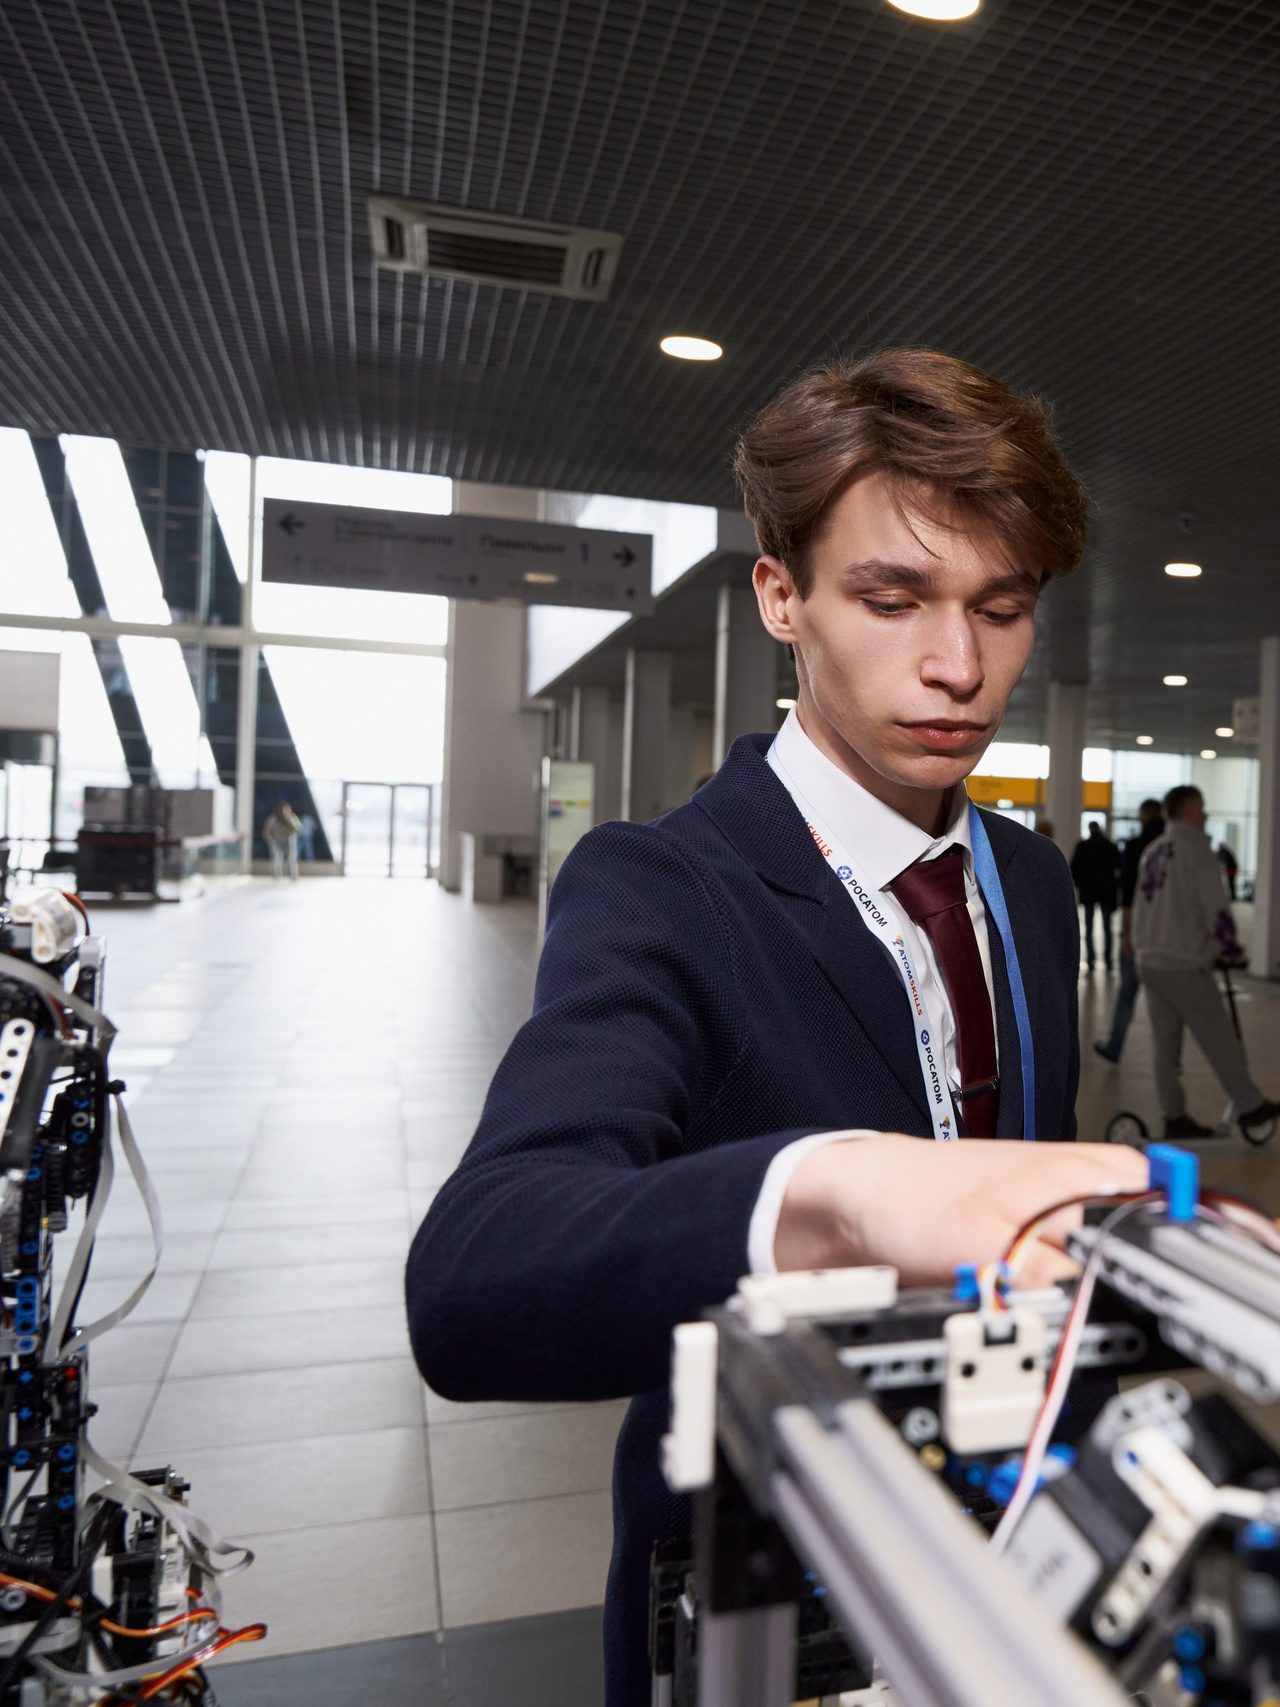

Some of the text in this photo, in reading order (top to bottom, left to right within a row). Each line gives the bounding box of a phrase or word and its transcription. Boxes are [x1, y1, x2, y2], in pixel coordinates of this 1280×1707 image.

[848, 879, 888, 927] РОСАТОМ
[898, 949, 923, 1016] ATOMSKILLS
[925, 1047, 943, 1105] РОСАТОМ
